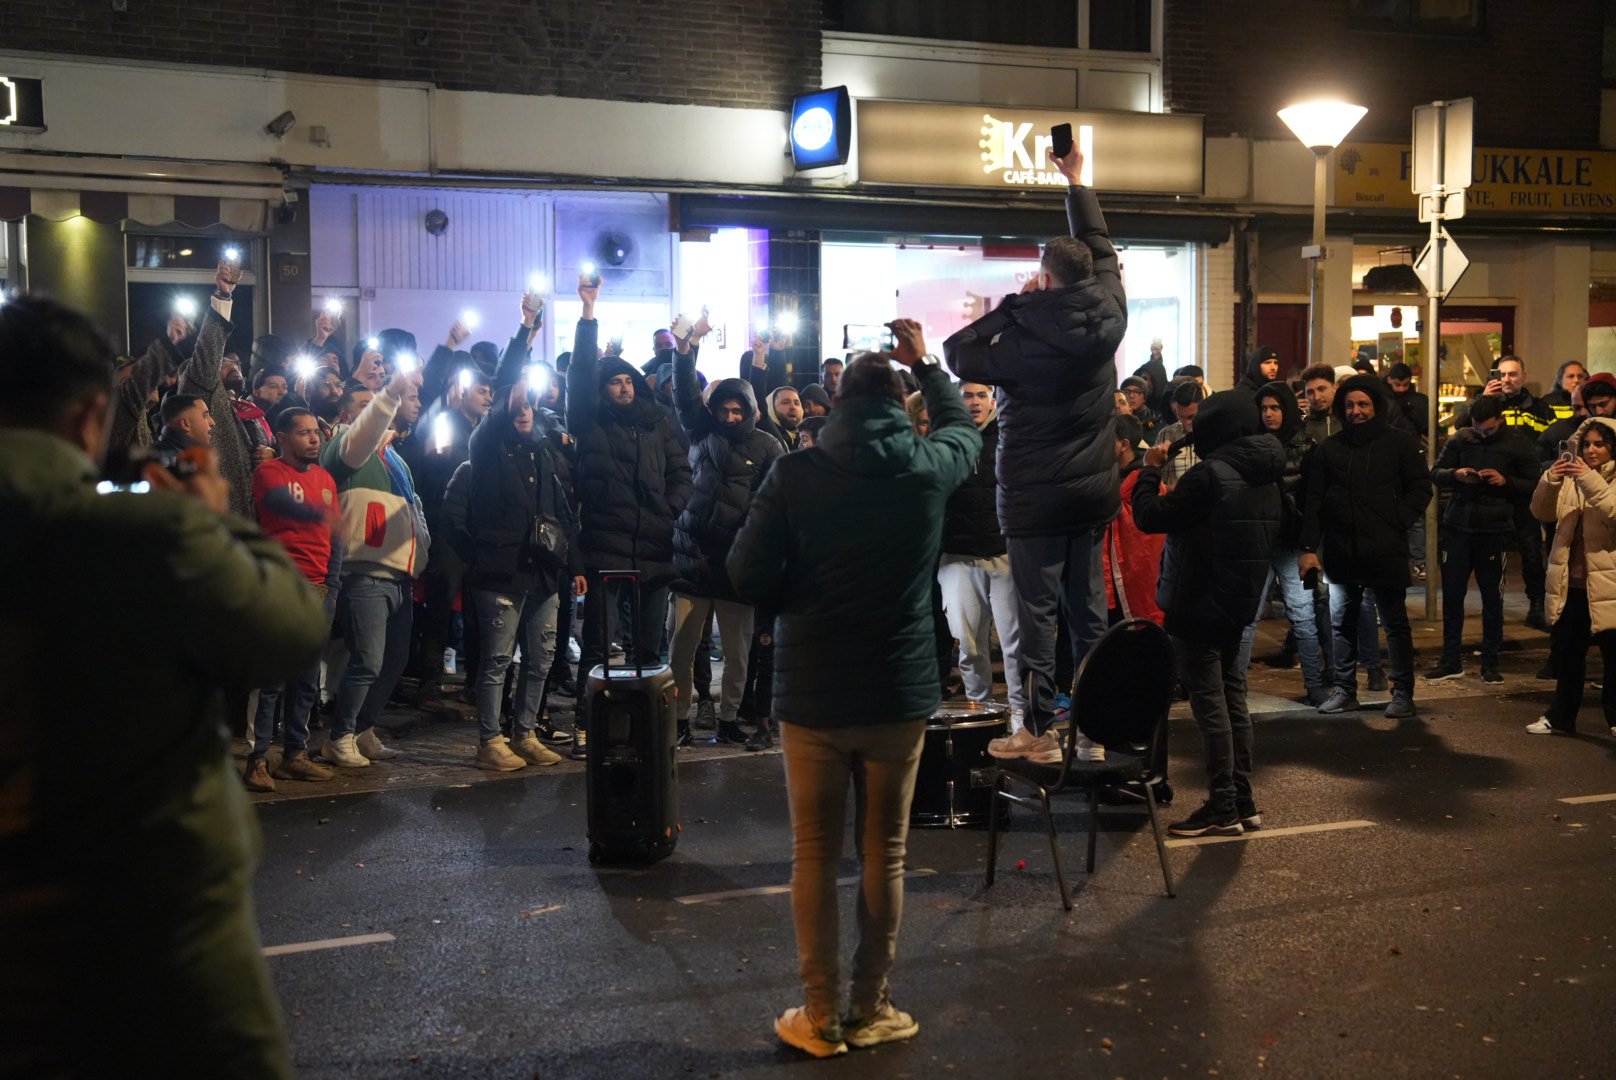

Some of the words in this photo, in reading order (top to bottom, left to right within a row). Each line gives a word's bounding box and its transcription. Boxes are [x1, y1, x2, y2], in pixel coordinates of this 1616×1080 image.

[1003, 122, 1093, 187] Krl
[1355, 192, 1384, 202] Biscuit
[1510, 191, 1552, 208] FRUIT,
[1563, 193, 1613, 208] LEVENS
[283, 264, 299, 276] 50
